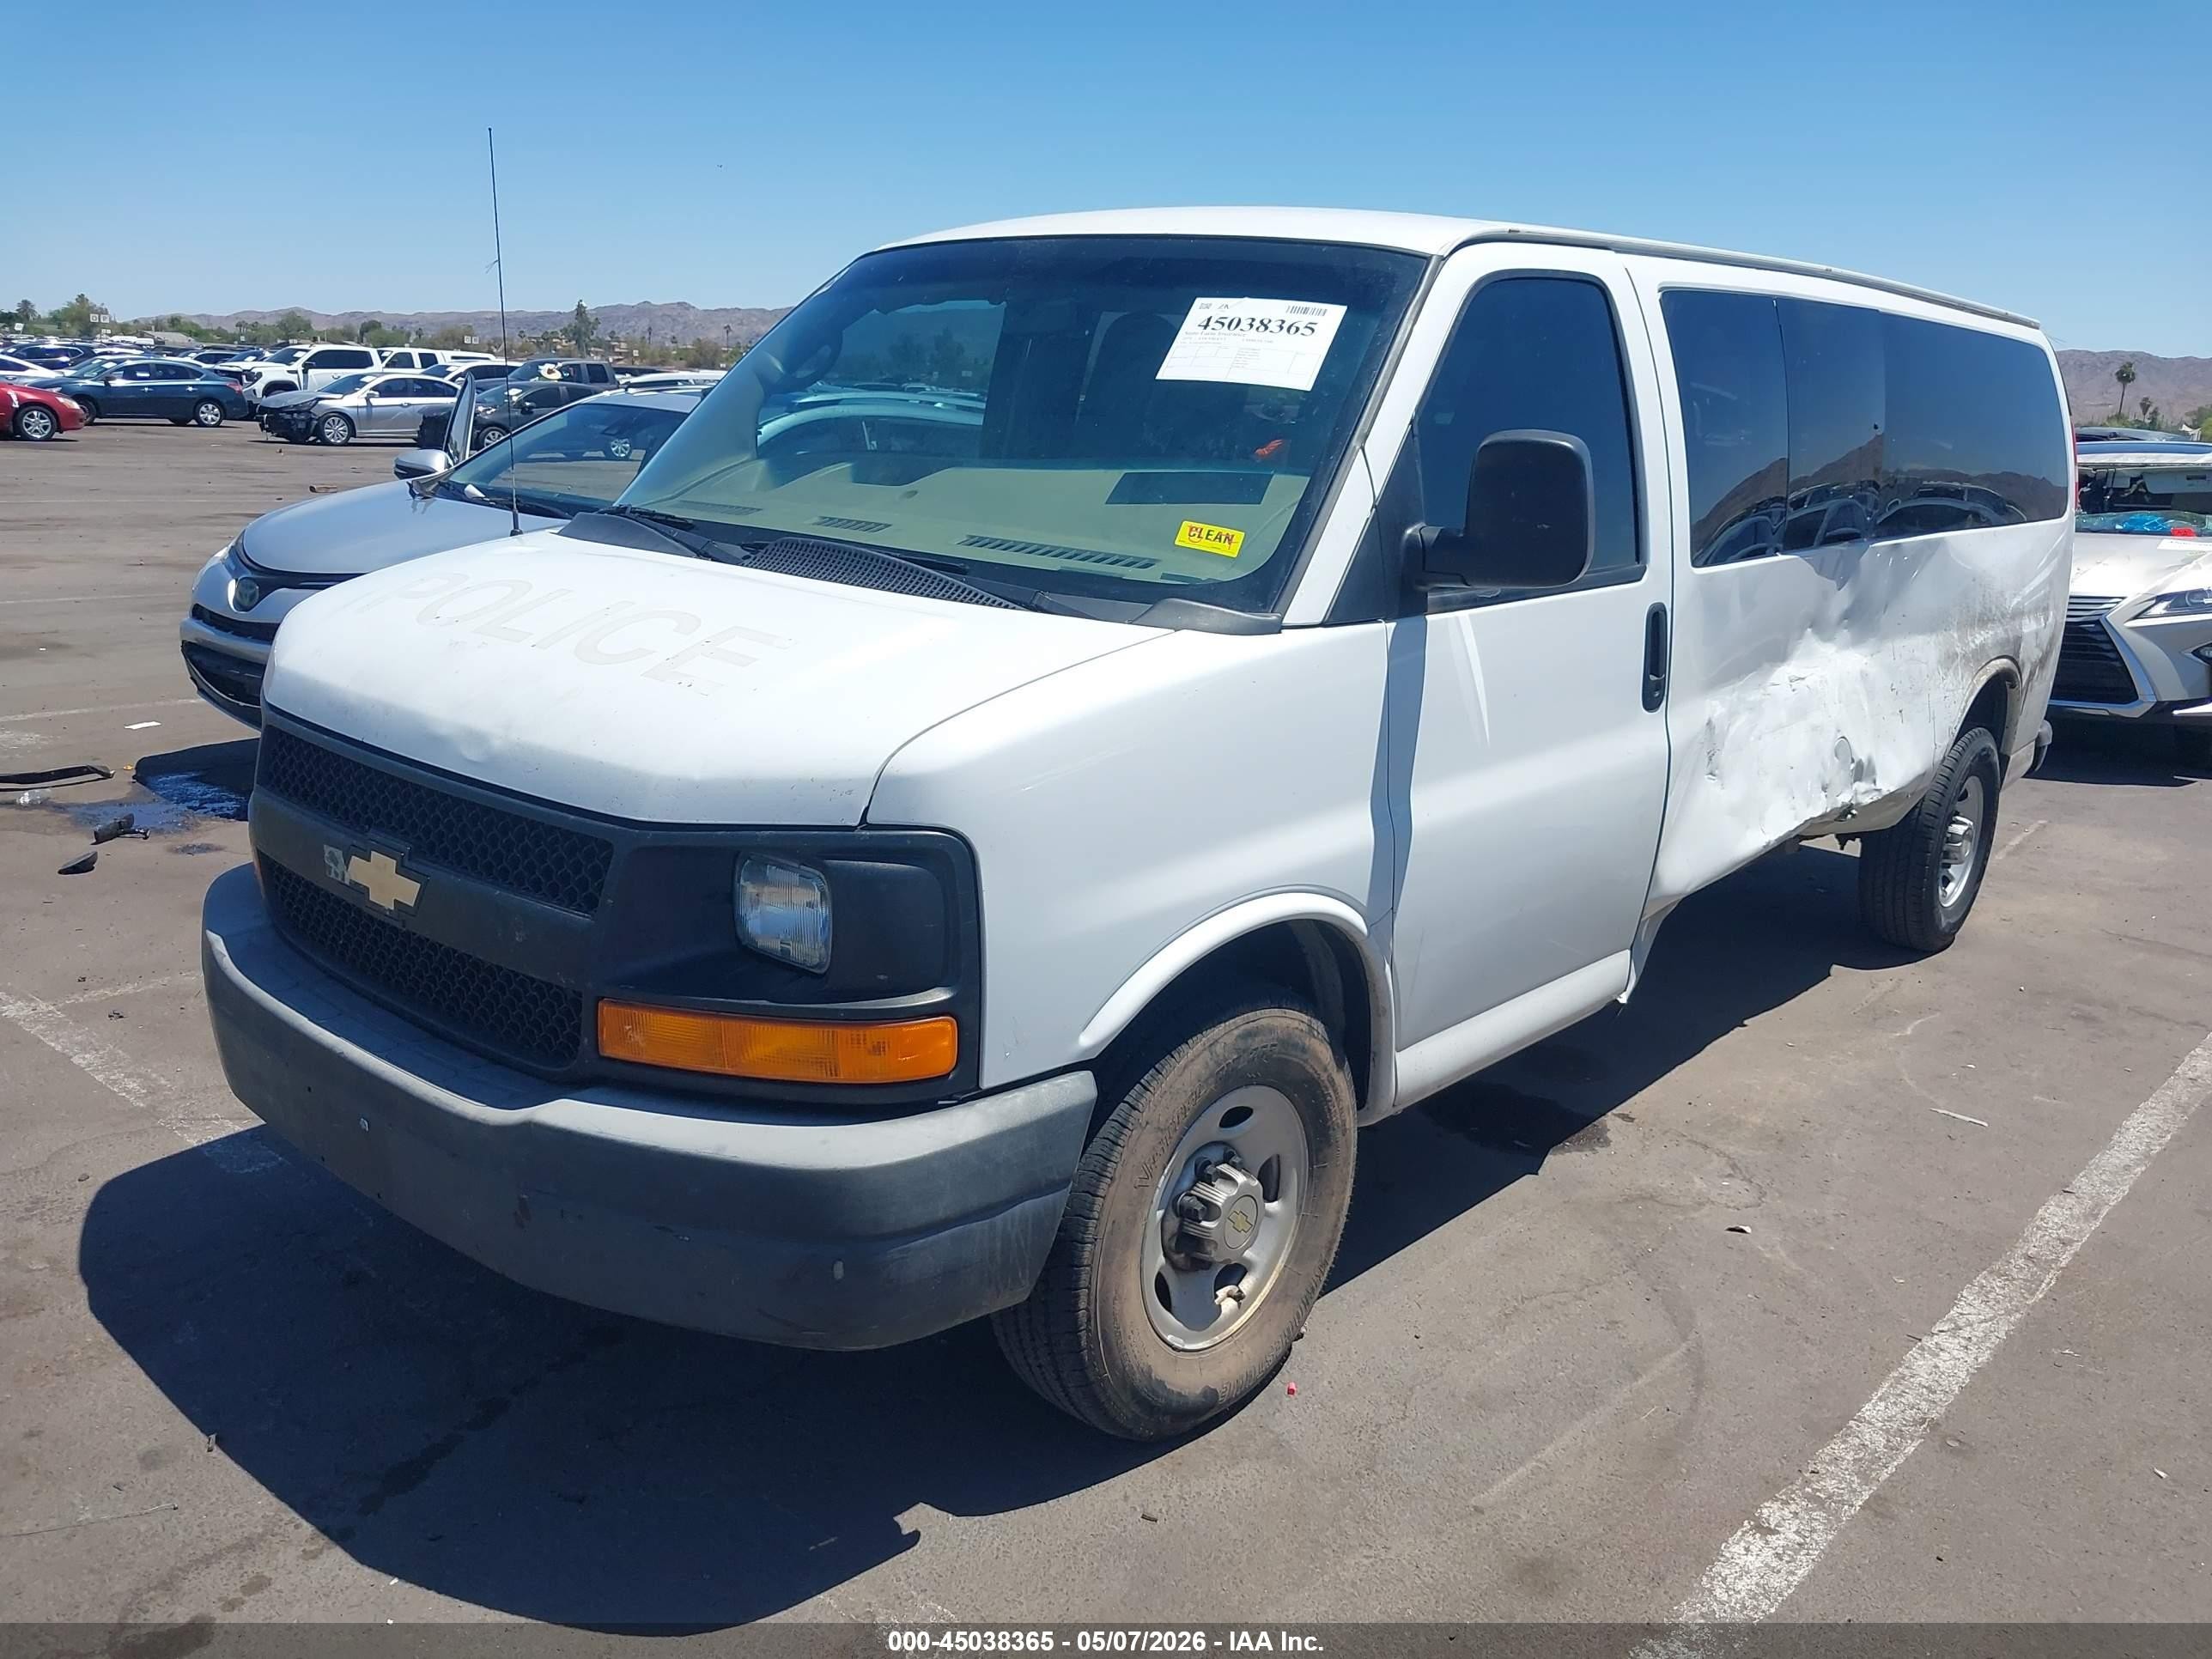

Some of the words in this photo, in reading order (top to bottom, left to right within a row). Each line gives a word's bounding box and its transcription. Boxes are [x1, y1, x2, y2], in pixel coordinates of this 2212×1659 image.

[1198, 315, 1317, 337] 45038365
[1188, 526, 1235, 544] CLEAN
[356, 572, 792, 691] POLICE
